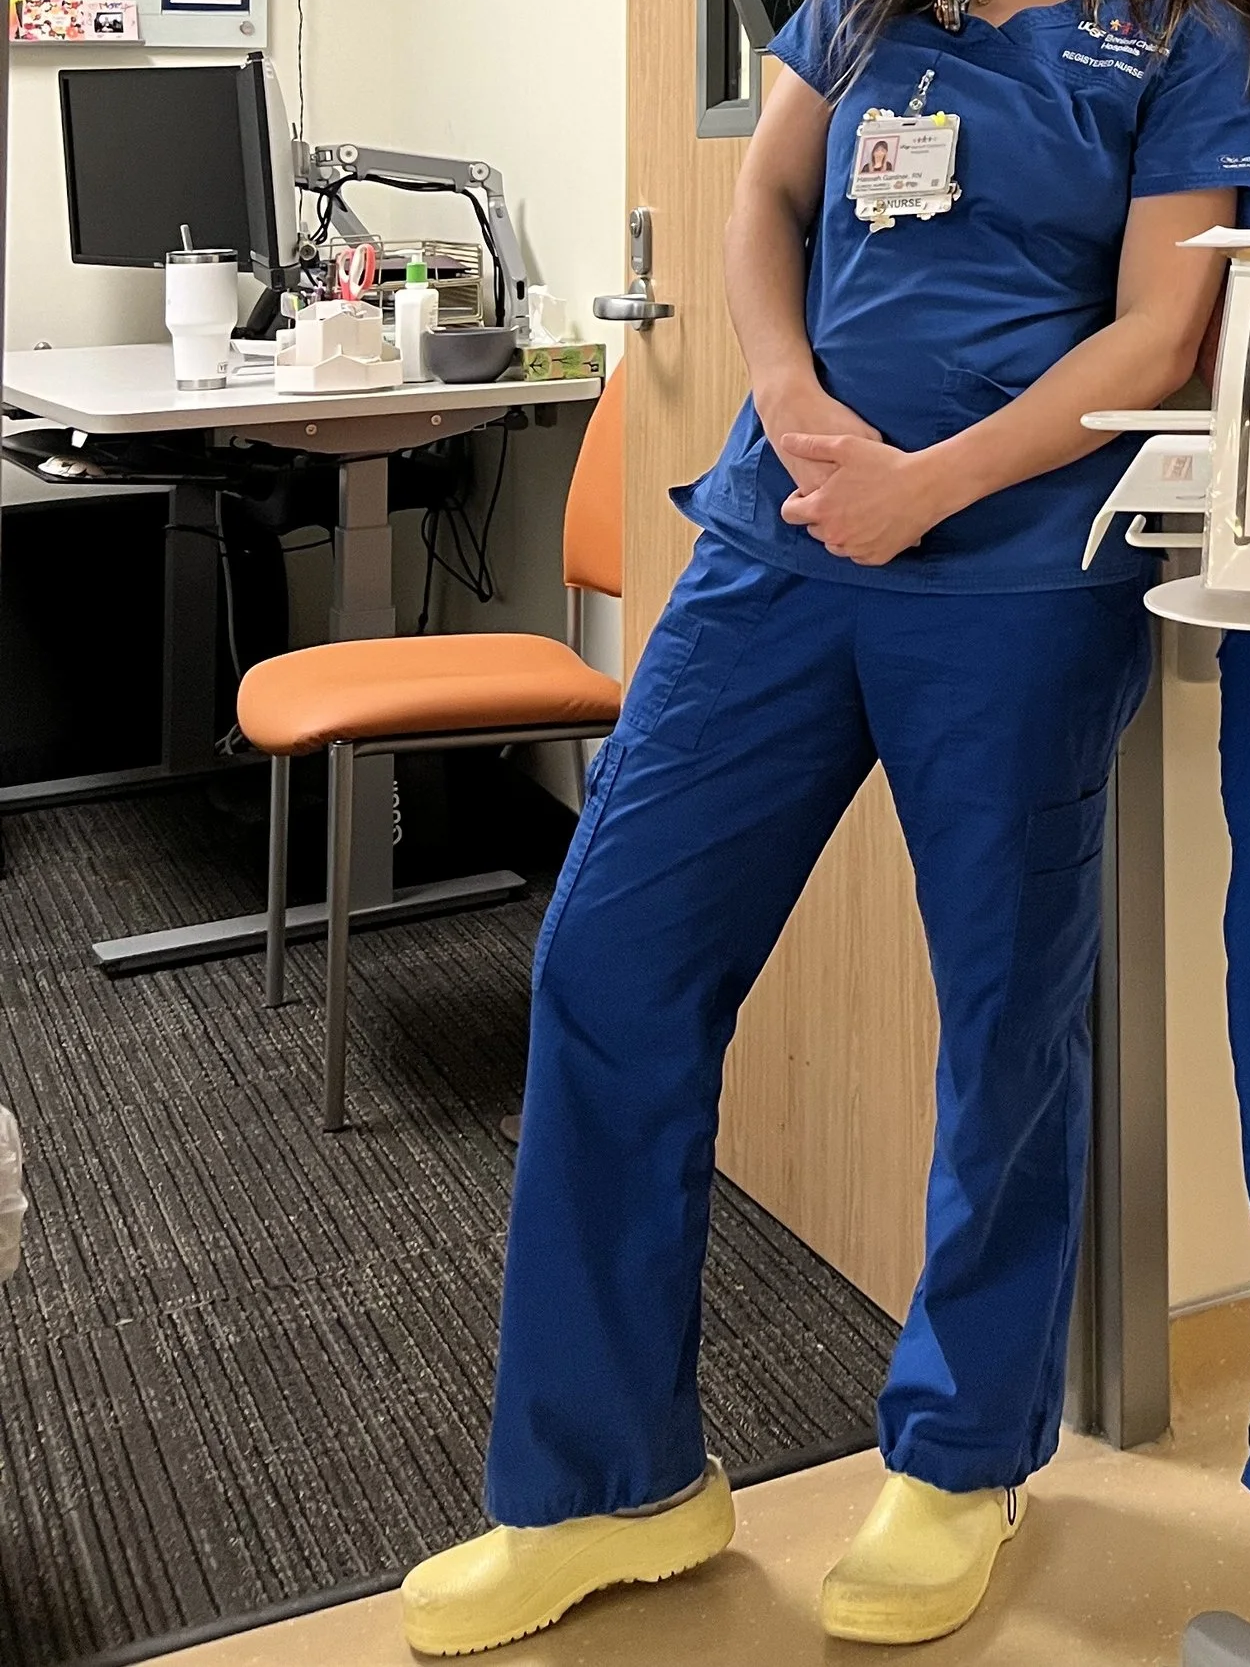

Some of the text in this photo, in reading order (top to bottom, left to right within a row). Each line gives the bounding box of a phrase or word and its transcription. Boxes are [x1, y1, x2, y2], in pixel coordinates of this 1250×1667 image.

[1078, 20, 1107, 38] UCSF
[1101, 42, 1140, 57] Hospitals
[1062, 50, 1144, 78] REGISTERED NURSE
[887, 198, 922, 209] NURSE
